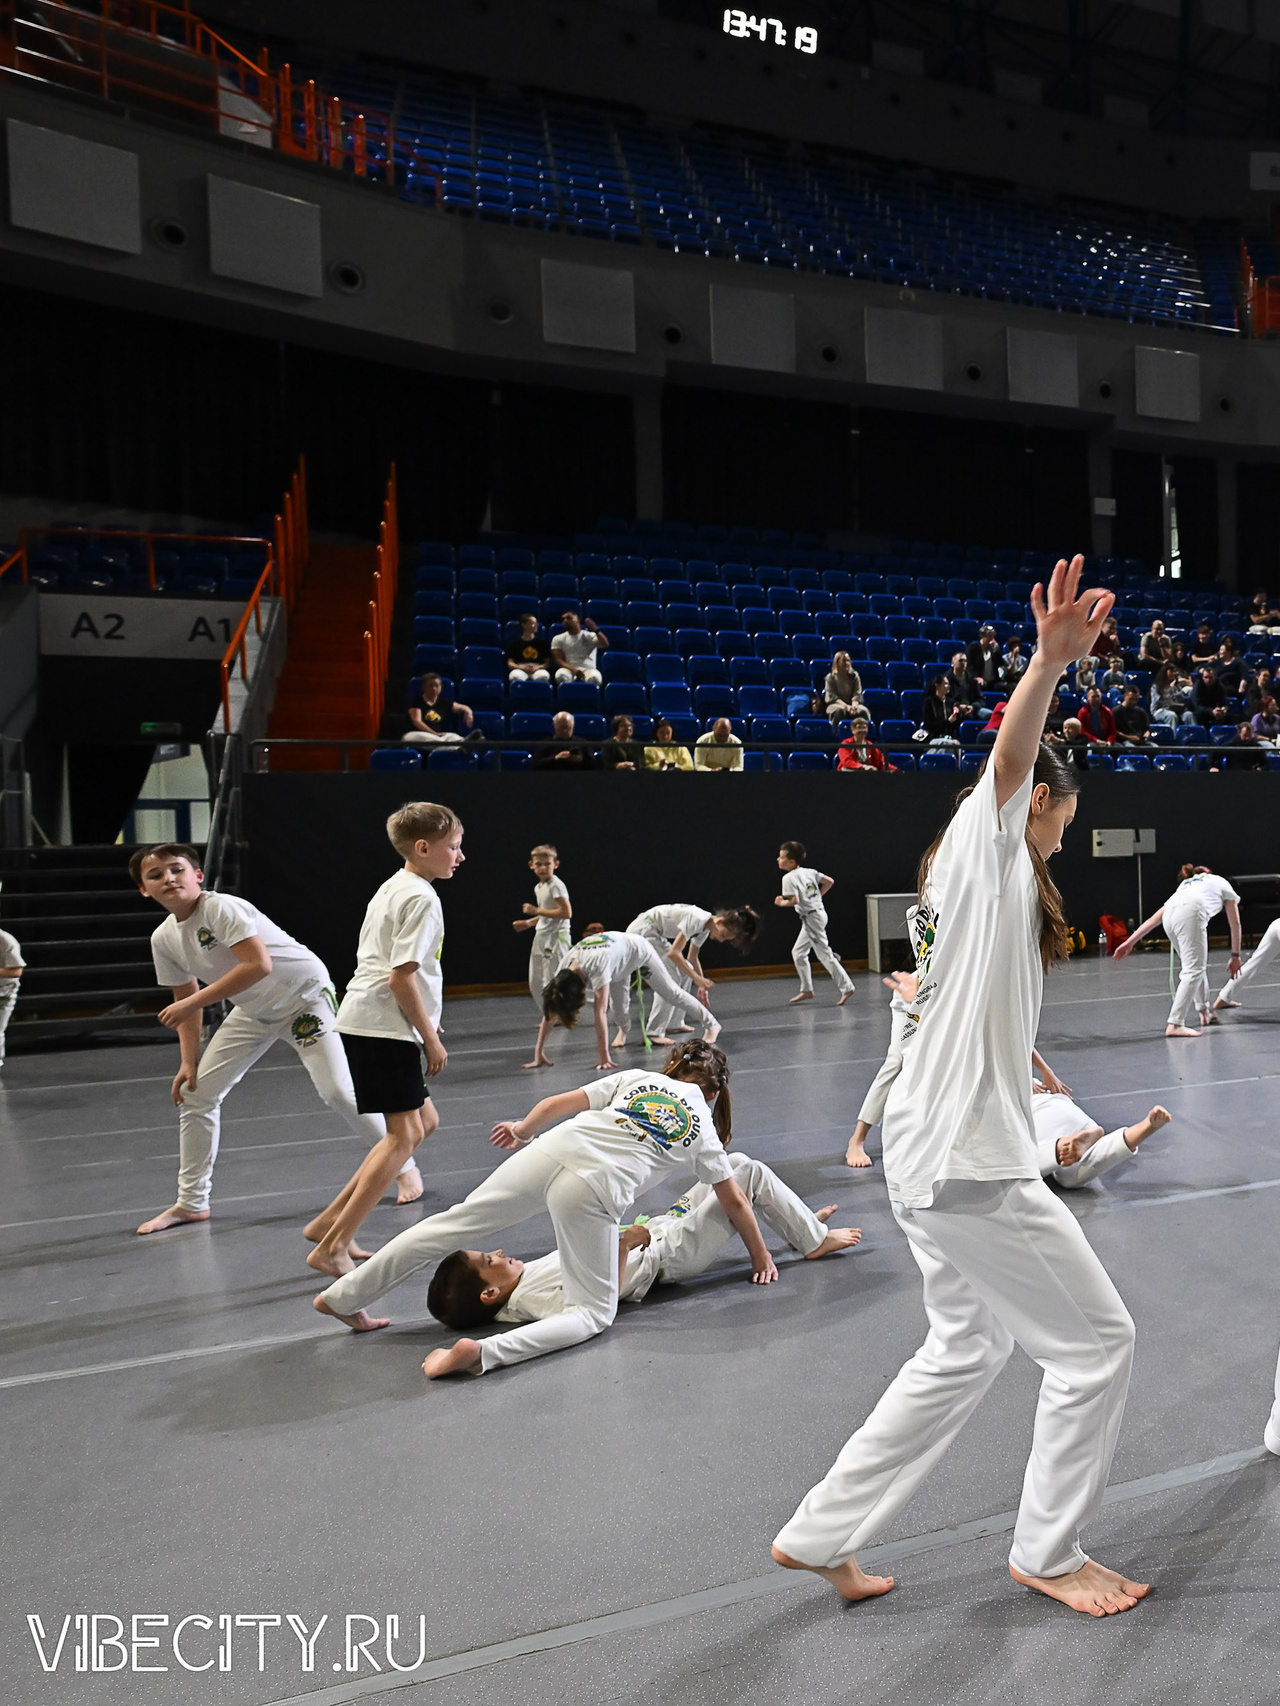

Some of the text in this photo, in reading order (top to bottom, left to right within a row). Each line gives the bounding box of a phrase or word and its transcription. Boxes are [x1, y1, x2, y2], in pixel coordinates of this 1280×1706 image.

[70, 611, 231, 643] A2 A1
[680, 1097, 694, 1112] DE
[682, 1114, 701, 1148] OURO
